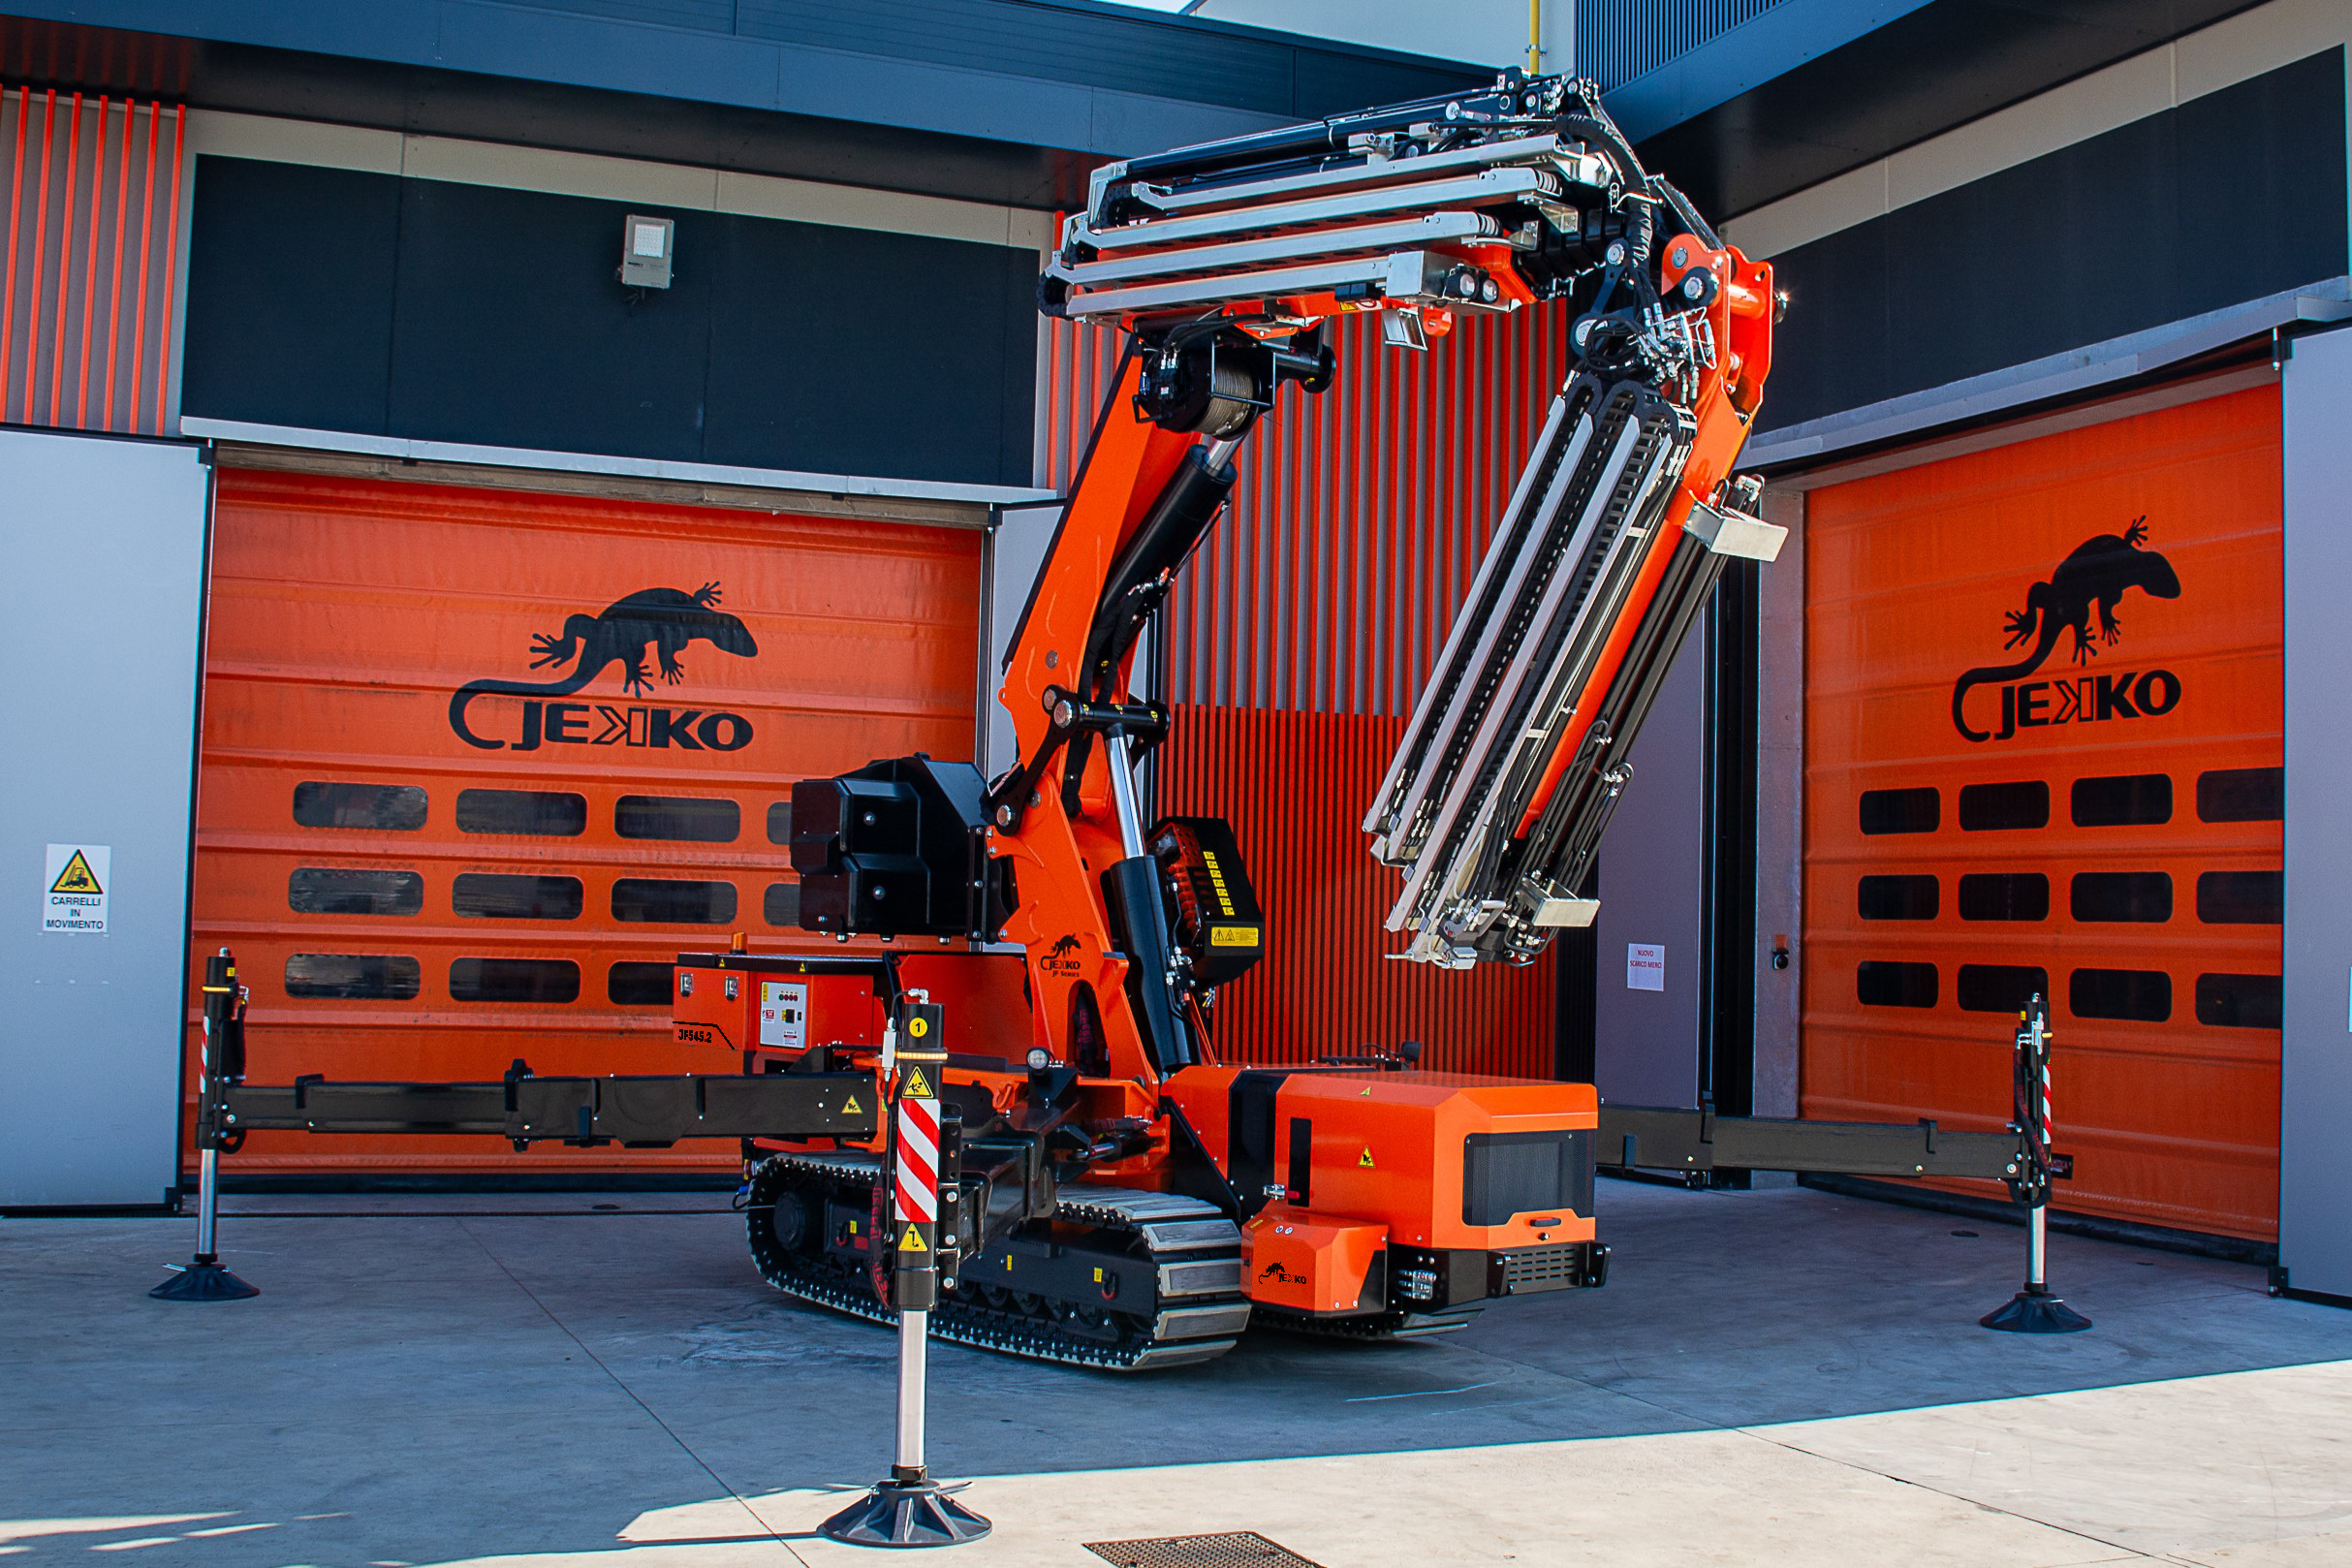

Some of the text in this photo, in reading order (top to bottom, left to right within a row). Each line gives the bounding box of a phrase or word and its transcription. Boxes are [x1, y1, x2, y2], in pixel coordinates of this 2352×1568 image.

[50, 896, 101, 906] CARRELLI
[70, 908, 81, 918] IN
[46, 919, 104, 929] MOVIMENTO
[915, 1021, 921, 1033] 1
